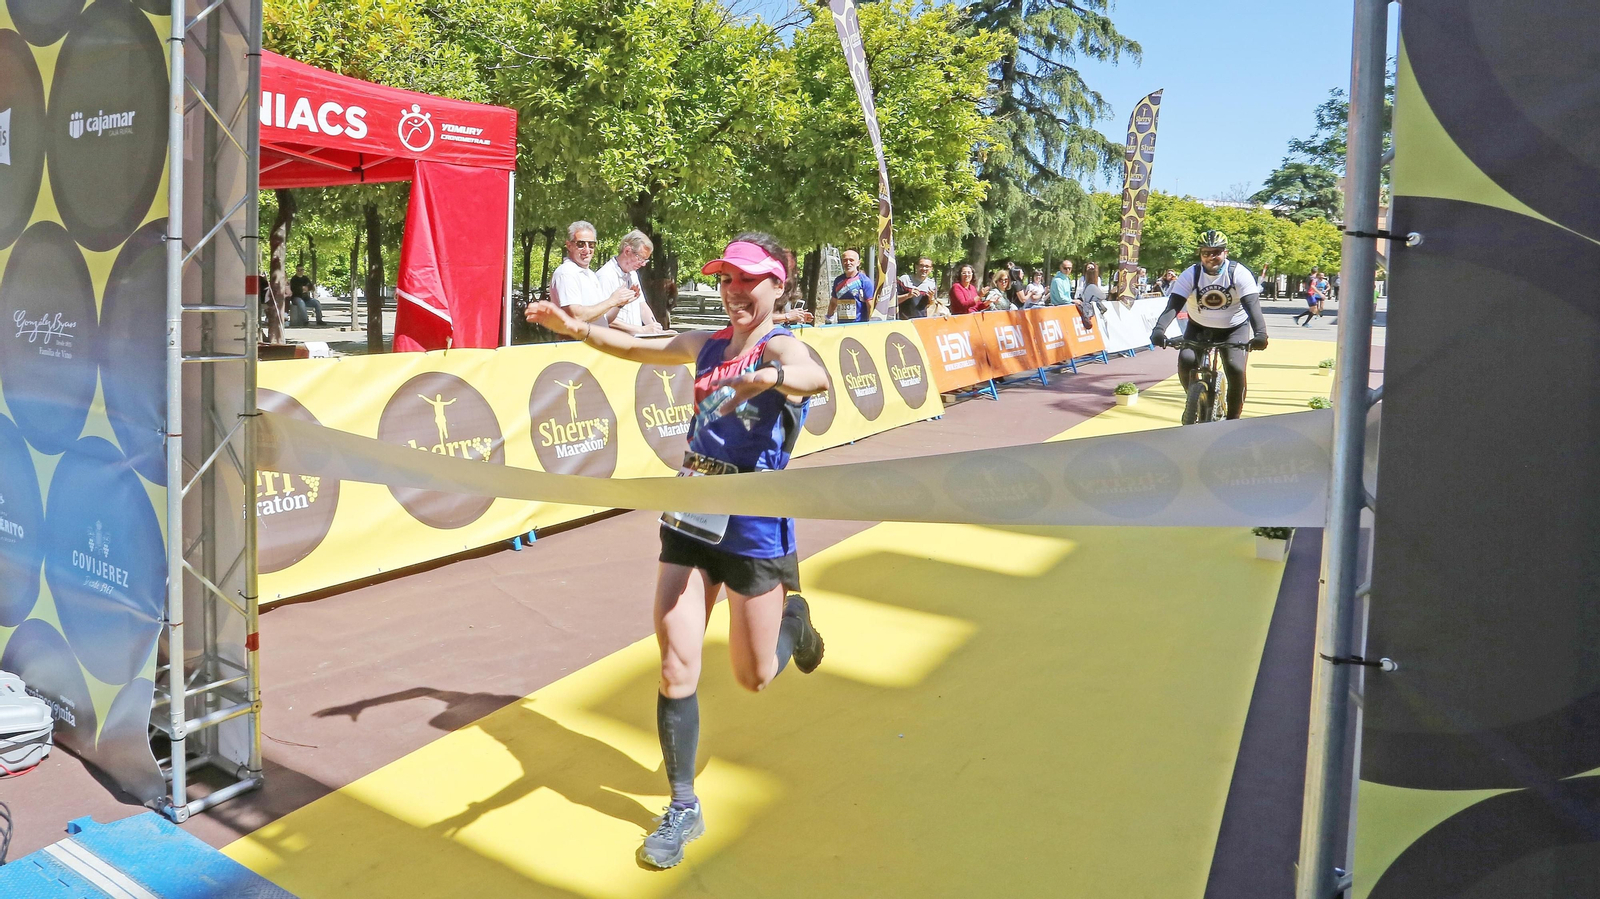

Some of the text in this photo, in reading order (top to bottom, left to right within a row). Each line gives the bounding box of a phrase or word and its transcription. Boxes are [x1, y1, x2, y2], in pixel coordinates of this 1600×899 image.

[86, 110, 136, 137] cajamar
[441, 123, 484, 136] YOMURY
[935, 330, 973, 363] HSN
[994, 324, 1025, 351] HSN
[846, 372, 877, 391] Sherry
[891, 364, 921, 382] Sherry
[538, 417, 609, 447] Sherry
[72, 549, 129, 588] COVIJEREZ
